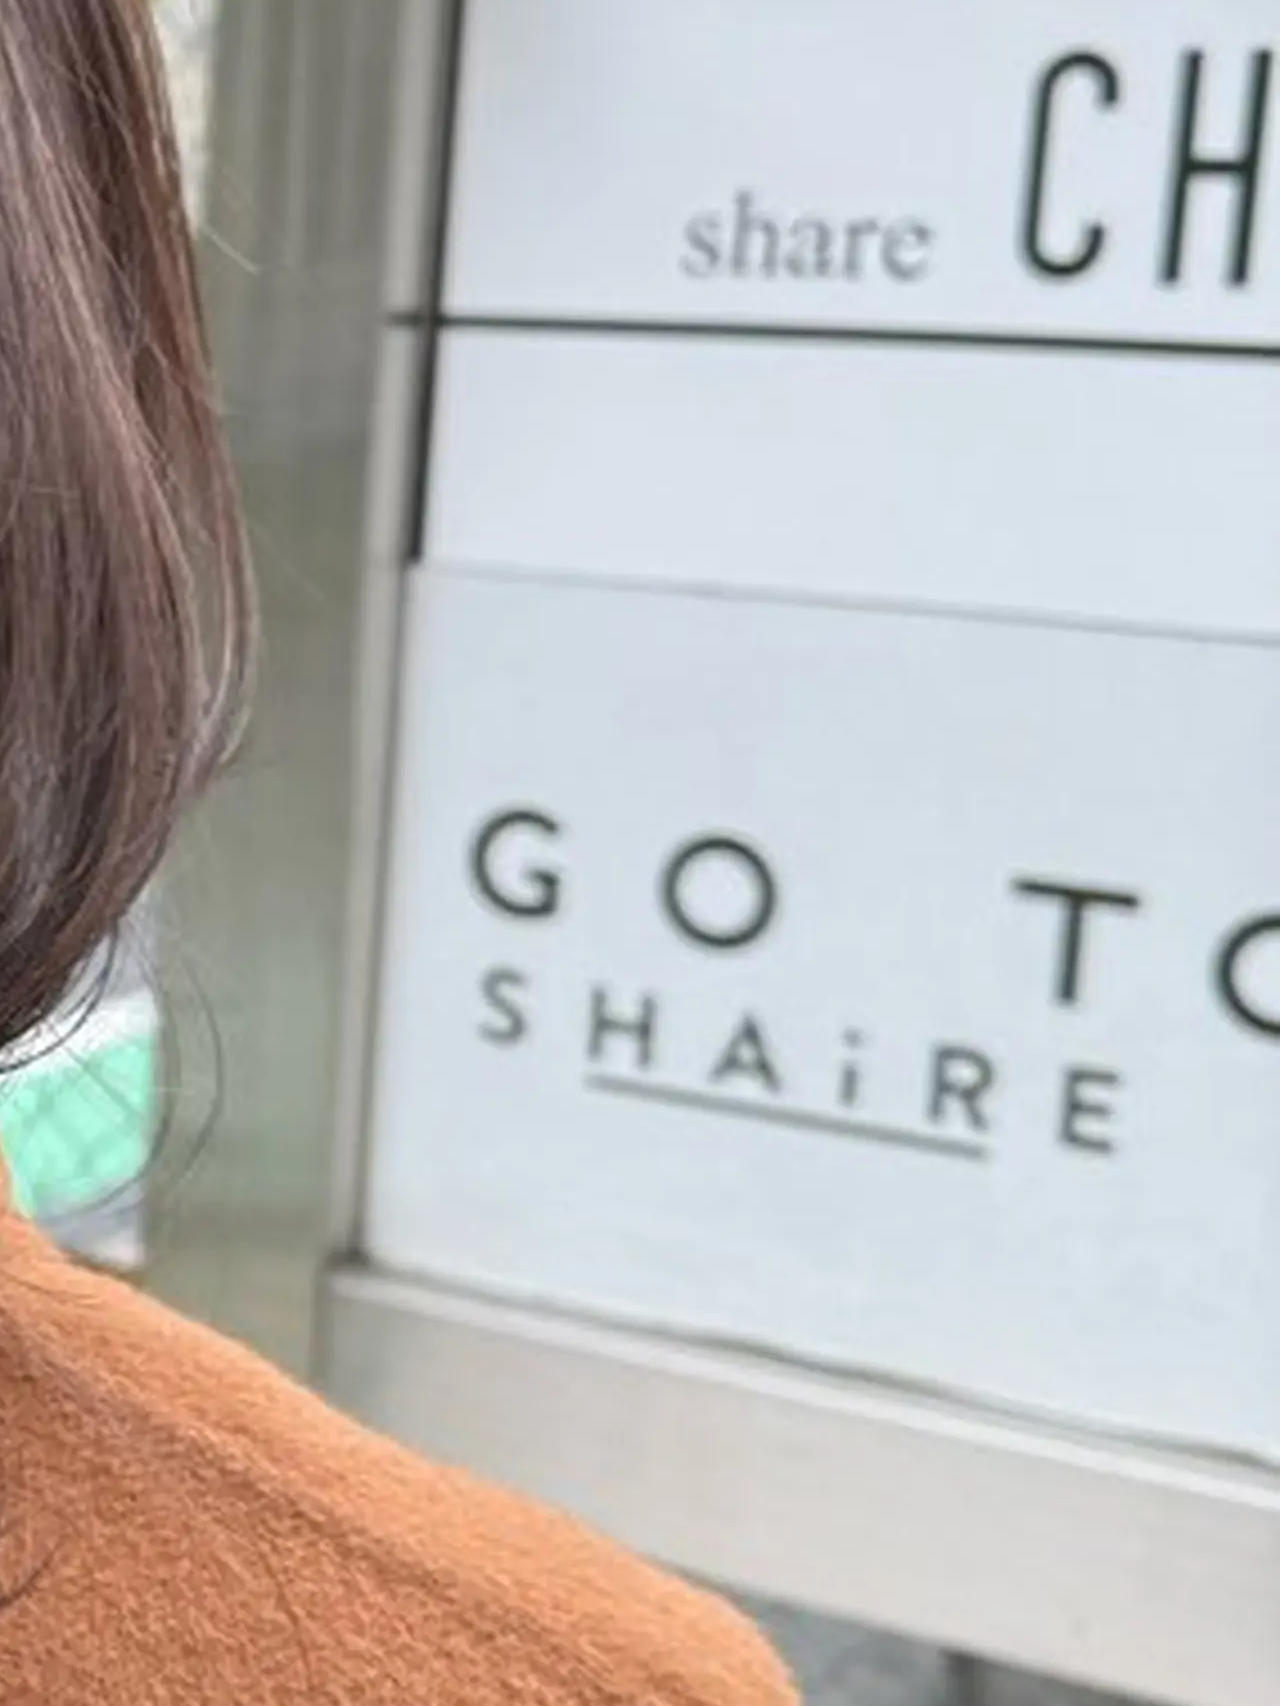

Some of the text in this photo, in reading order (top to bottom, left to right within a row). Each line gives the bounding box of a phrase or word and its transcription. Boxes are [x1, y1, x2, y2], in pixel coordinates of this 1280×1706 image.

[680, 47, 1271, 287] share CH
[470, 807, 777, 950] GO
